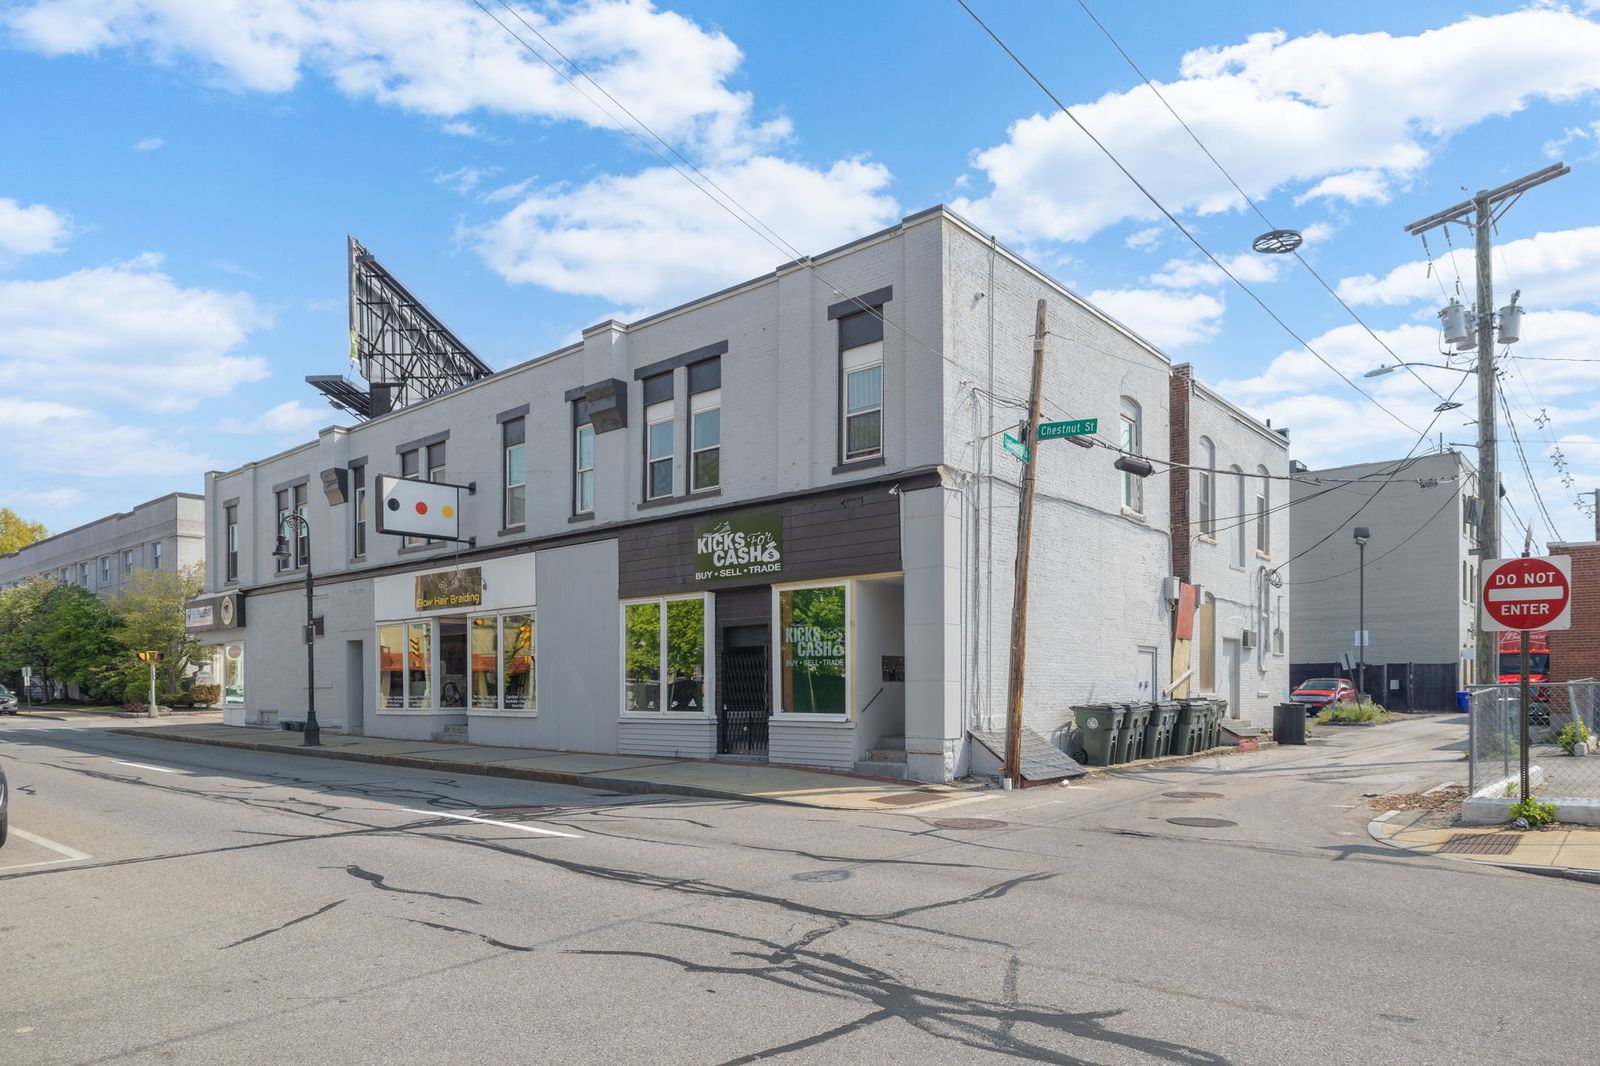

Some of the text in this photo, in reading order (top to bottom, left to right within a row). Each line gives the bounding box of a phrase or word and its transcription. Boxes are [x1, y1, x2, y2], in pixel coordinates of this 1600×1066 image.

[1041, 422, 1095, 436] Chestnut St
[697, 532, 745, 555] KICKS
[713, 545, 762, 567] CASH
[695, 563, 781, 580] BUY SELL TRADE
[1496, 571, 1556, 586] DO NOT
[434, 596, 449, 605] Hair
[450, 593, 480, 604] Braiding
[1501, 603, 1550, 616] ENTER
[785, 626, 821, 643] KICKS
[797, 640, 832, 657] CASH
